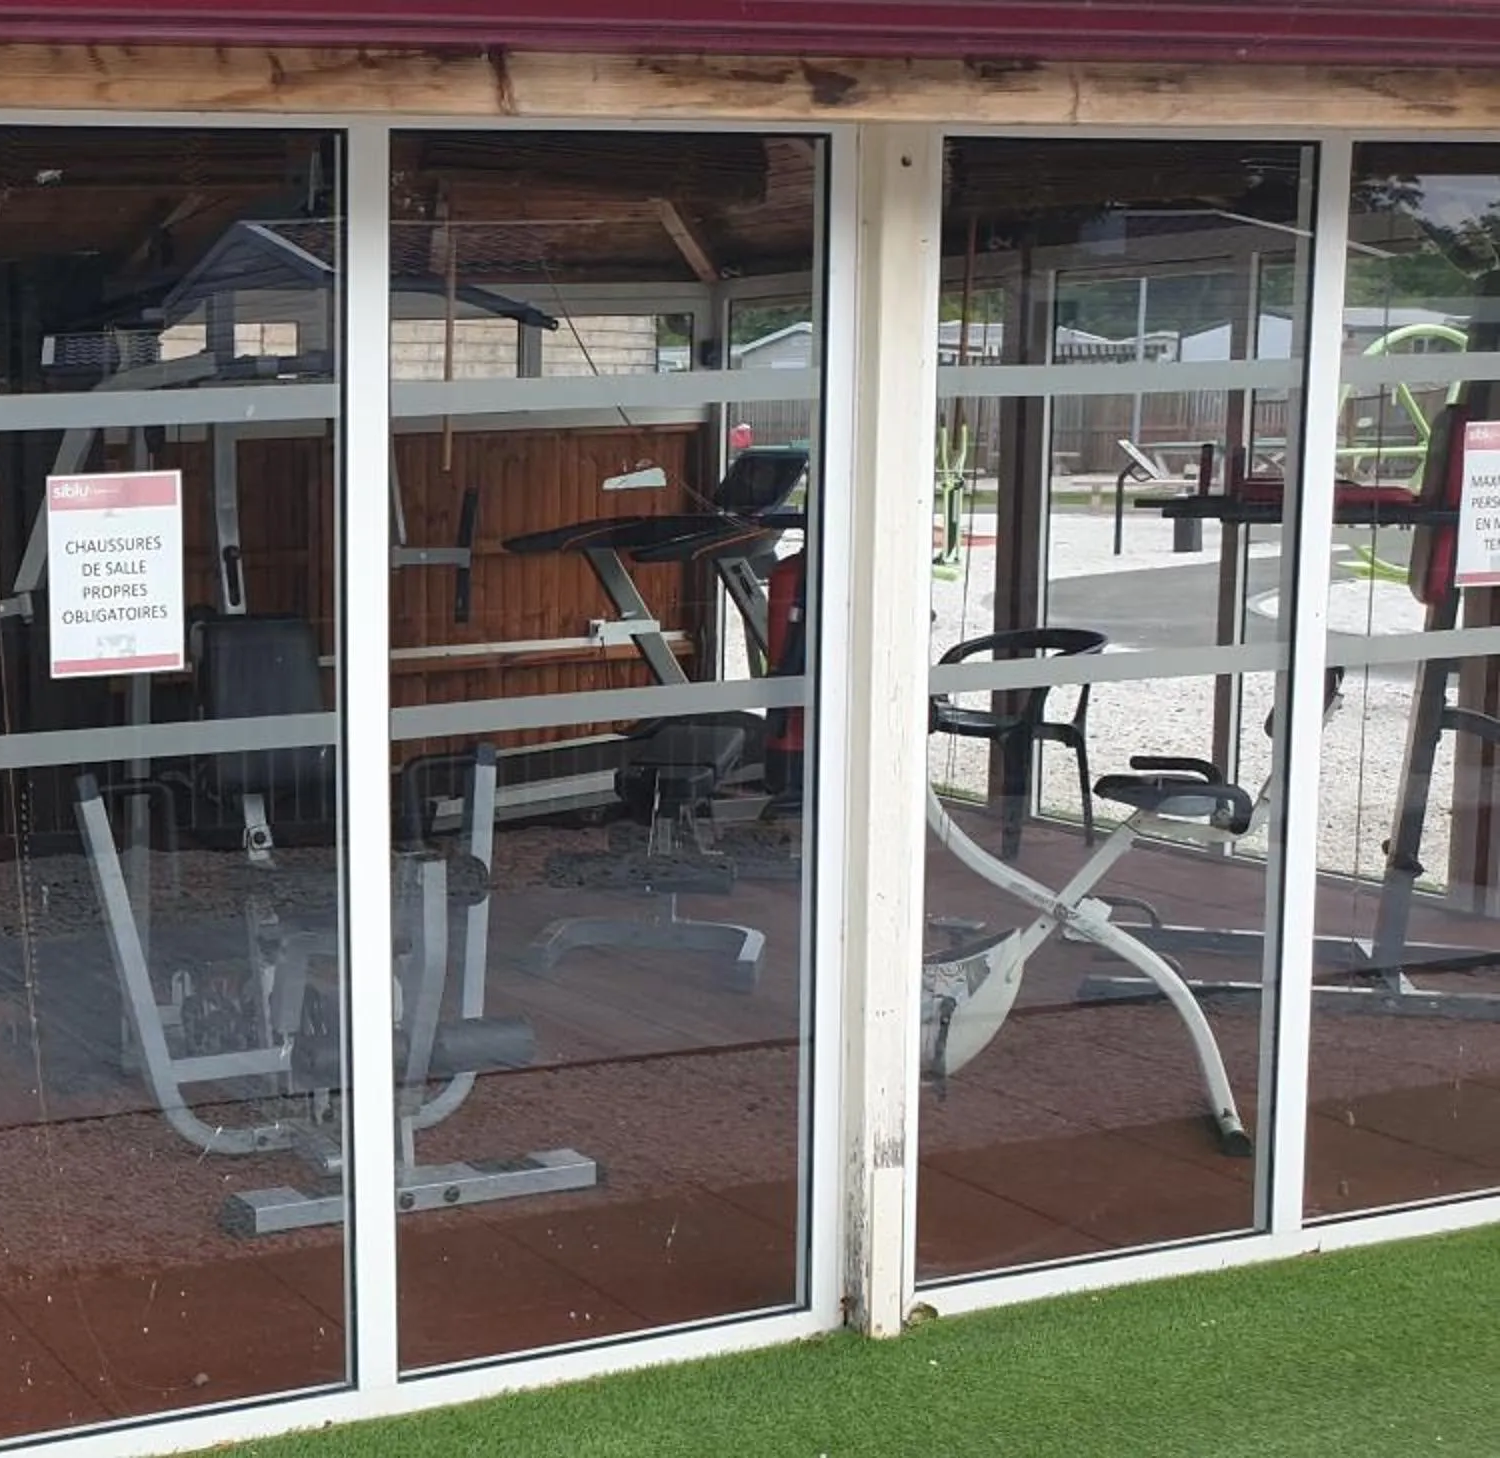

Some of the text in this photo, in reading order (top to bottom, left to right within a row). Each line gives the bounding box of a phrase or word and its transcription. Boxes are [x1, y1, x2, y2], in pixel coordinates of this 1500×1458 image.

[52, 483, 89, 499] siblu
[1476, 517, 1491, 530] EN
[65, 536, 162, 554] CHAUSSURES
[82, 560, 147, 577] DE SALLE
[83, 584, 148, 600] PROPRES
[62, 605, 168, 625] OBLIGATOIRES
